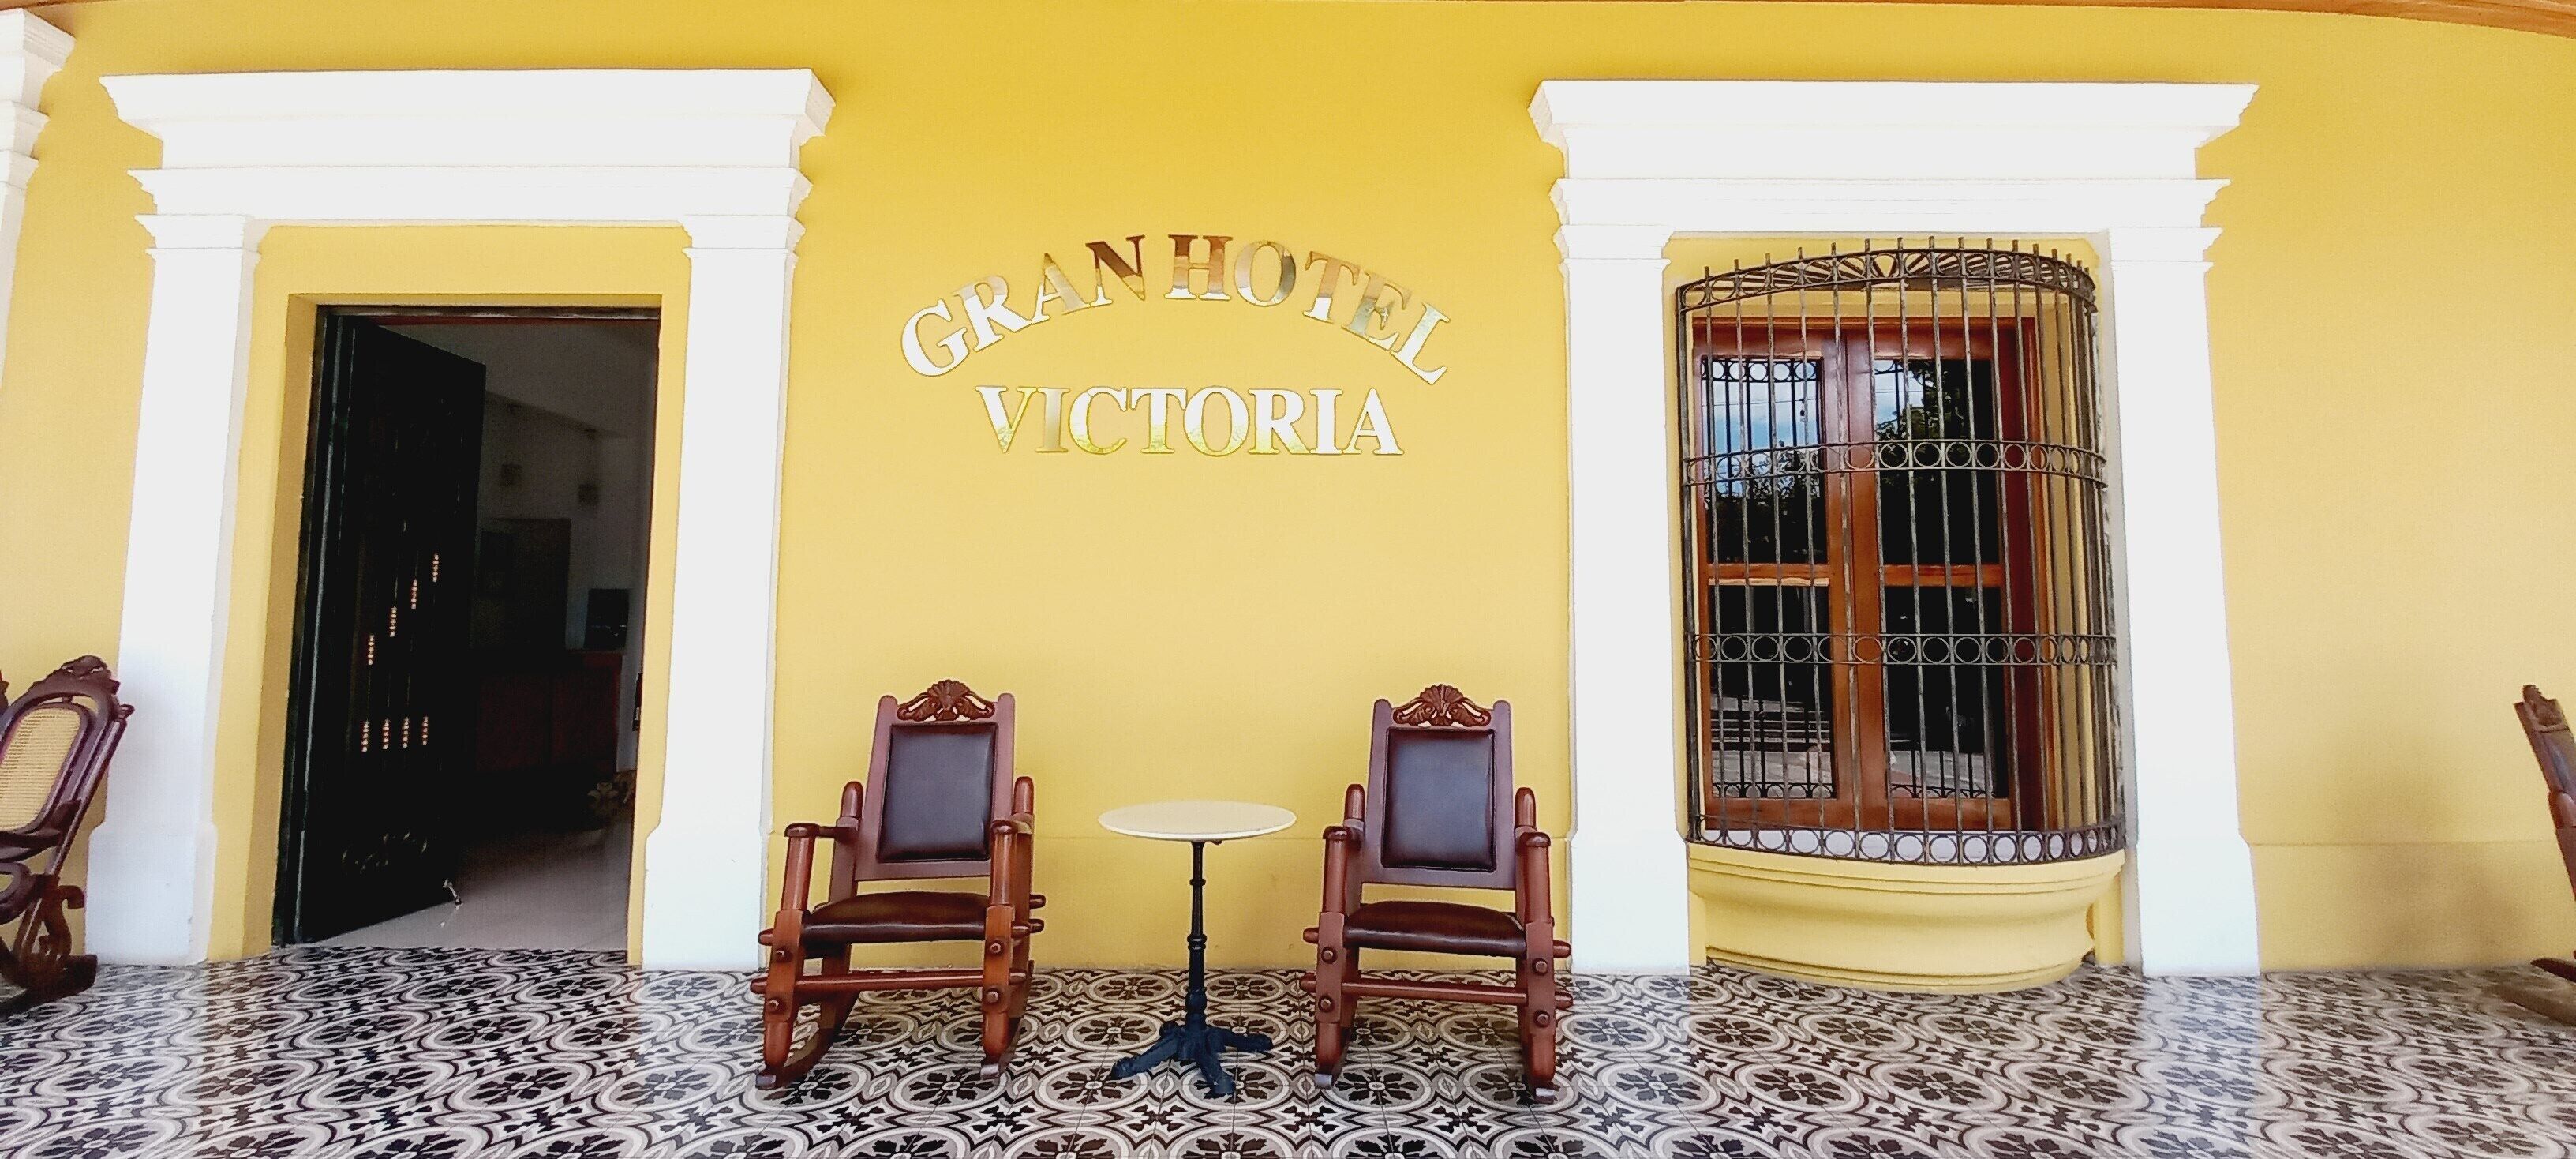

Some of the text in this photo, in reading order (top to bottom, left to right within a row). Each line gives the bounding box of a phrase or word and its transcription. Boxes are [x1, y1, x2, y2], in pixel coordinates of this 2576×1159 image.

[900, 234, 1451, 385] GRAN HOTEL
[975, 384, 1405, 456] VICTORIA
